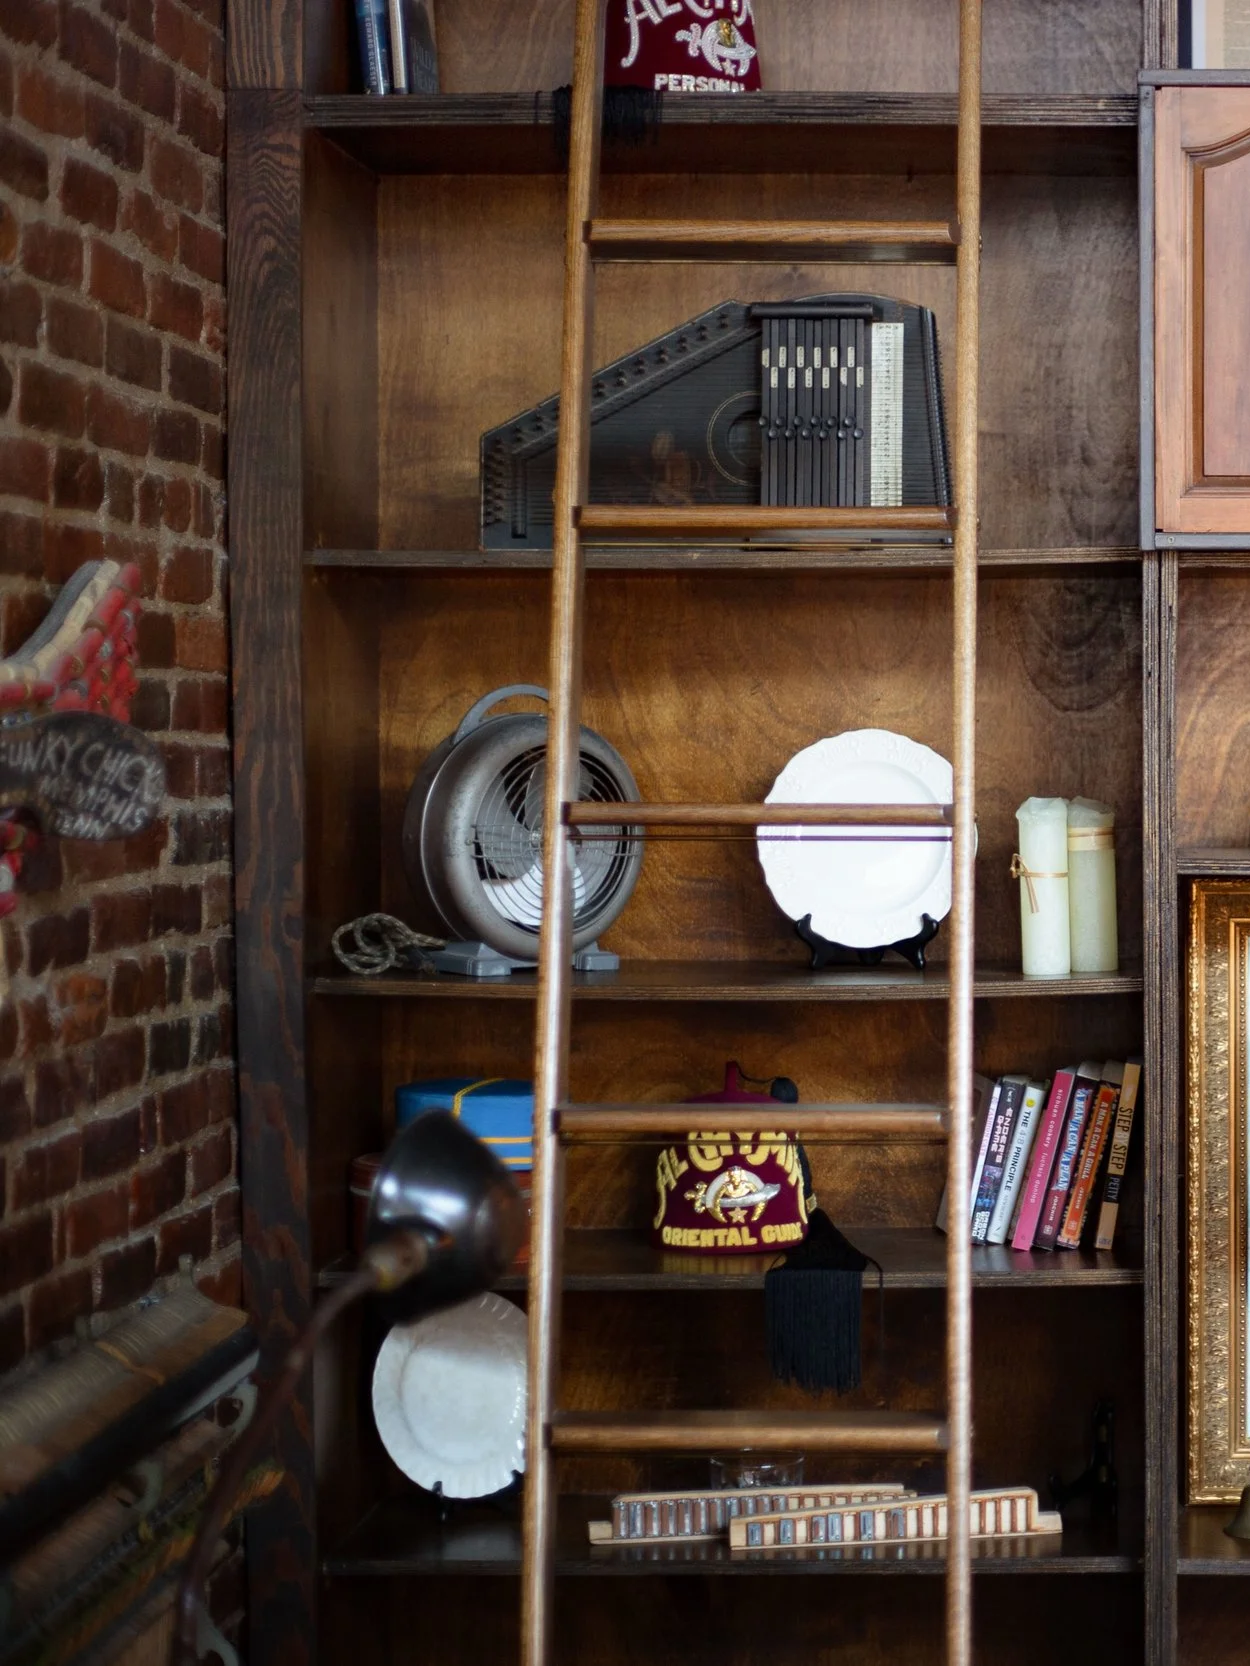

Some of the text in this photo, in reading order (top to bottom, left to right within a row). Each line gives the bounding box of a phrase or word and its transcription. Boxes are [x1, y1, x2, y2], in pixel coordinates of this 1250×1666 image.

[1021, 1111, 1031, 1128] THE
[1116, 1106, 1132, 1132] STEP
[991, 1115, 1004, 1152] GAME
[995, 1107, 1013, 1163] ENDER'S
[1043, 1120, 1056, 1148] cookery
[1066, 1131, 1078, 1151] CAN
[1004, 1146, 1022, 1191] PRINCIPLE
[1110, 1143, 1124, 1169] STEP
[1057, 1163, 1071, 1189] PLAN
[662, 1225, 757, 1247] ORIENTAL
